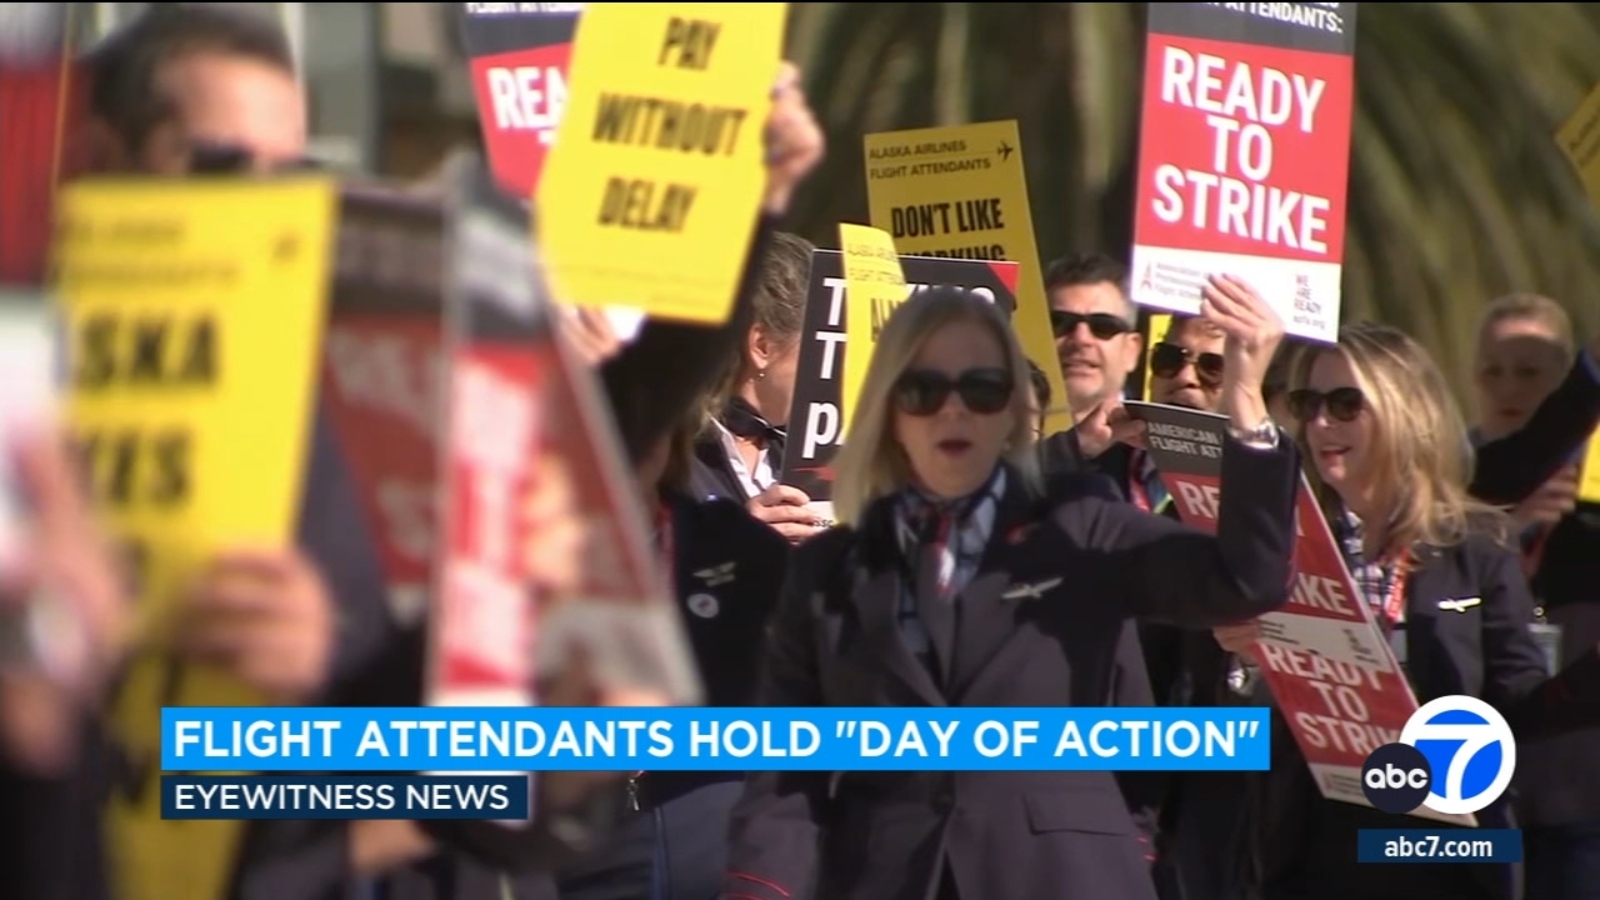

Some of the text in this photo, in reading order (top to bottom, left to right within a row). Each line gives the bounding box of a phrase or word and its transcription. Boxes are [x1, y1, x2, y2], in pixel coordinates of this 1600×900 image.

[658, 17, 721, 71] PAY
[486, 66, 568, 129] REA
[1161, 45, 1326, 134] READY
[592, 91, 748, 156] WITHOUT
[869, 140, 967, 160] ALASKA AIRLINES
[1206, 114, 1273, 182] TO
[870, 158, 991, 179] FLIGHT ATTENDANTS
[597, 176, 698, 234] DELAY
[891, 198, 1004, 238] DON'T LIKE
[1152, 163, 1331, 254] STRIKE
[1148, 421, 1219, 444] AMERICAN
[1149, 436, 1198, 456] FLIGHT
[1307, 681, 1370, 722] TO
